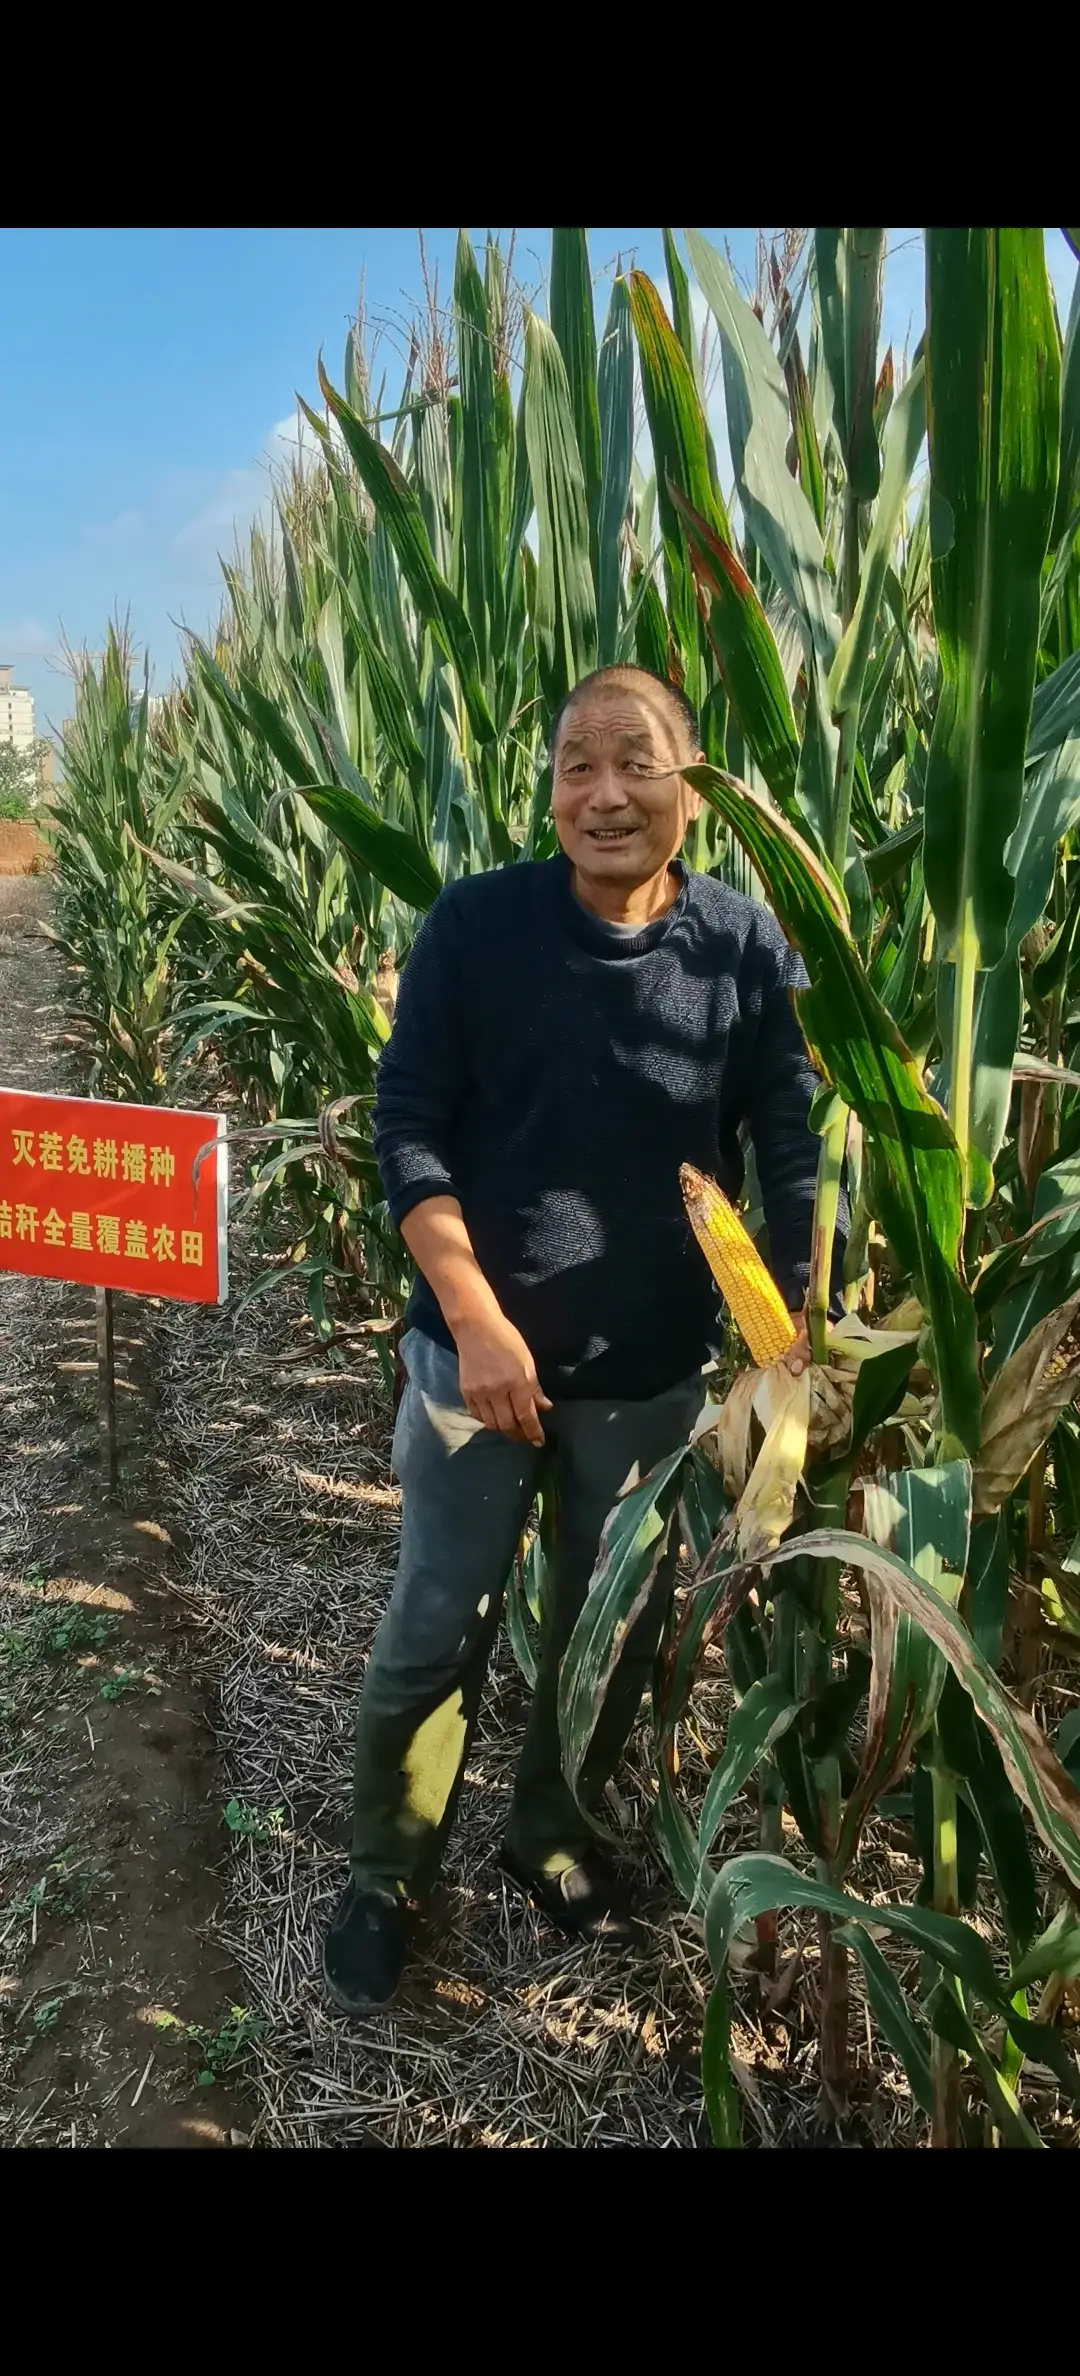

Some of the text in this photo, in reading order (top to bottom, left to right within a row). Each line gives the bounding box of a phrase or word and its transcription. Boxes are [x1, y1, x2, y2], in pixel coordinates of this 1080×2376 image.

[11, 1129, 175, 1187] 灭茬免耕播种
